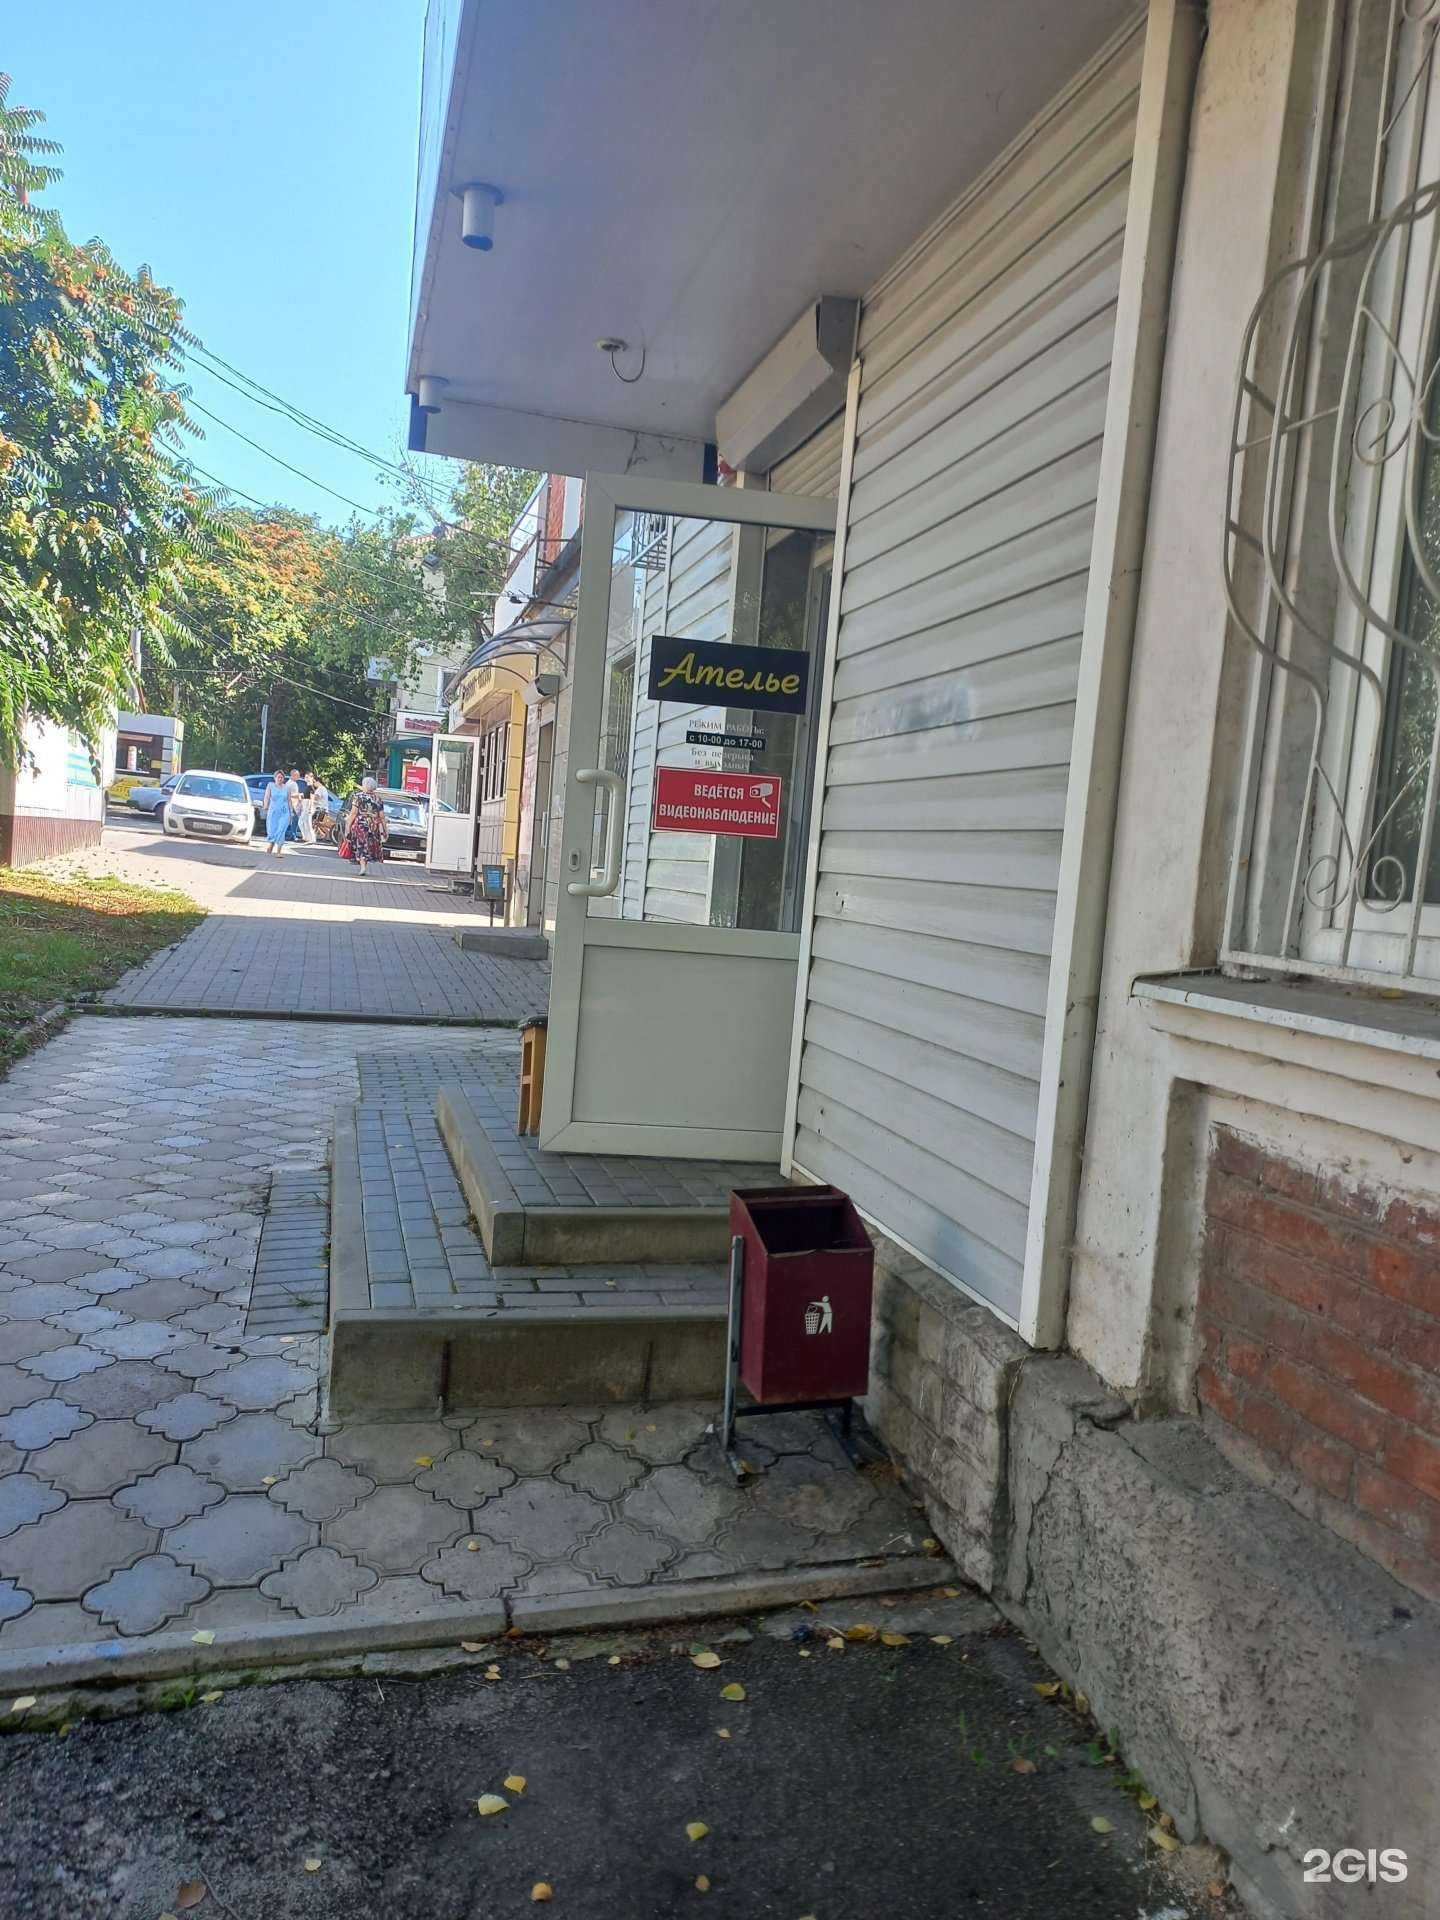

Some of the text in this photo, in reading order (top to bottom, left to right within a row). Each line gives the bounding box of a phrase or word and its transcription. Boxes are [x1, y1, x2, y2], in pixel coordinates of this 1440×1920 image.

[657, 652, 800, 694] Ателье
[689, 719, 722, 730] РЕЖИМ
[698, 734, 722, 744] 10-00
[724, 738, 736, 746] до
[739, 738, 763, 748] 17-00
[711, 750, 754, 762] пеерыва
[694, 783, 744, 800] ВЕДЁТСЯ
[658, 804, 776, 825] ВИДЕОНАБЛЮДЕНИЕ
